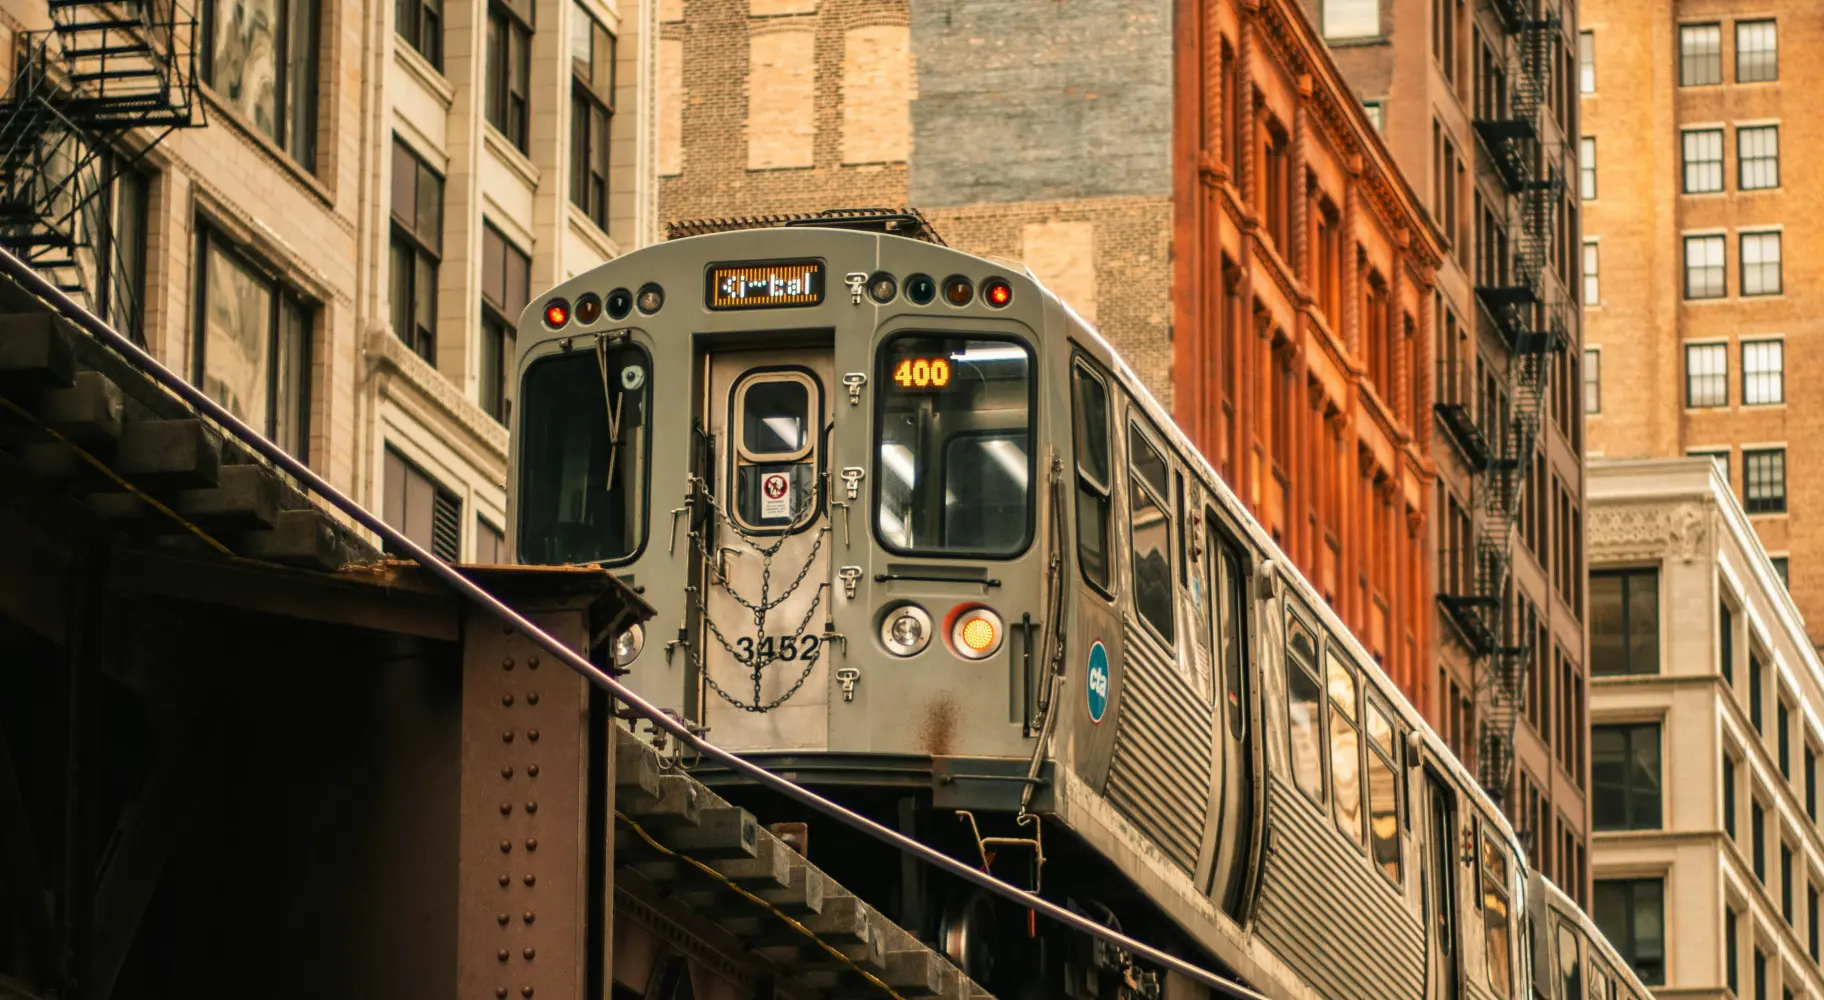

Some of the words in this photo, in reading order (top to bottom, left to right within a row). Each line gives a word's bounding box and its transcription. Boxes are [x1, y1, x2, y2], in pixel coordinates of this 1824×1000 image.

[894, 359, 949, 387] 400
[736, 634, 820, 662] 3452
[1089, 667, 1107, 698] cta
